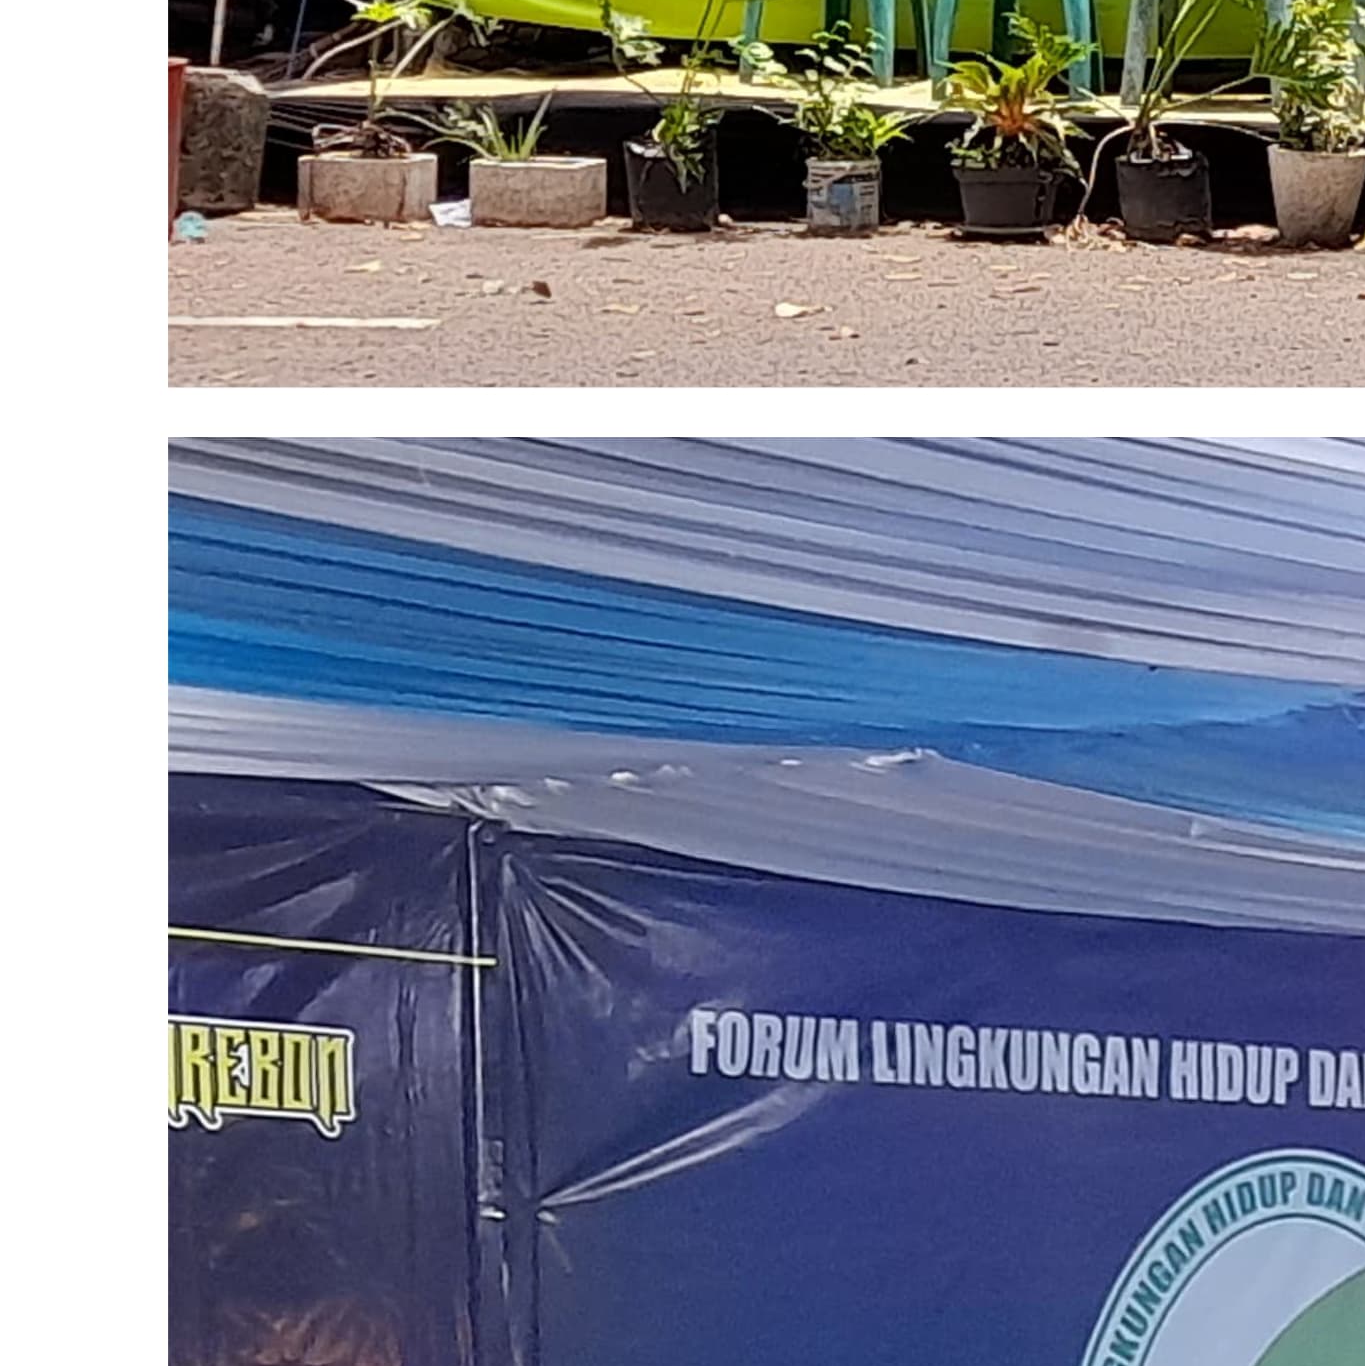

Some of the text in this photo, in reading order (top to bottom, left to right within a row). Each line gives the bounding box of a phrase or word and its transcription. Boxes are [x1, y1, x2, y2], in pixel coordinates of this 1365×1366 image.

[690, 1010, 859, 1081] FORUM
[871, 1020, 1160, 1098] LINGKUNGAN
[1169, 1039, 1300, 1106] HIDUP
[1202, 1171, 1297, 1236] HIDUP
